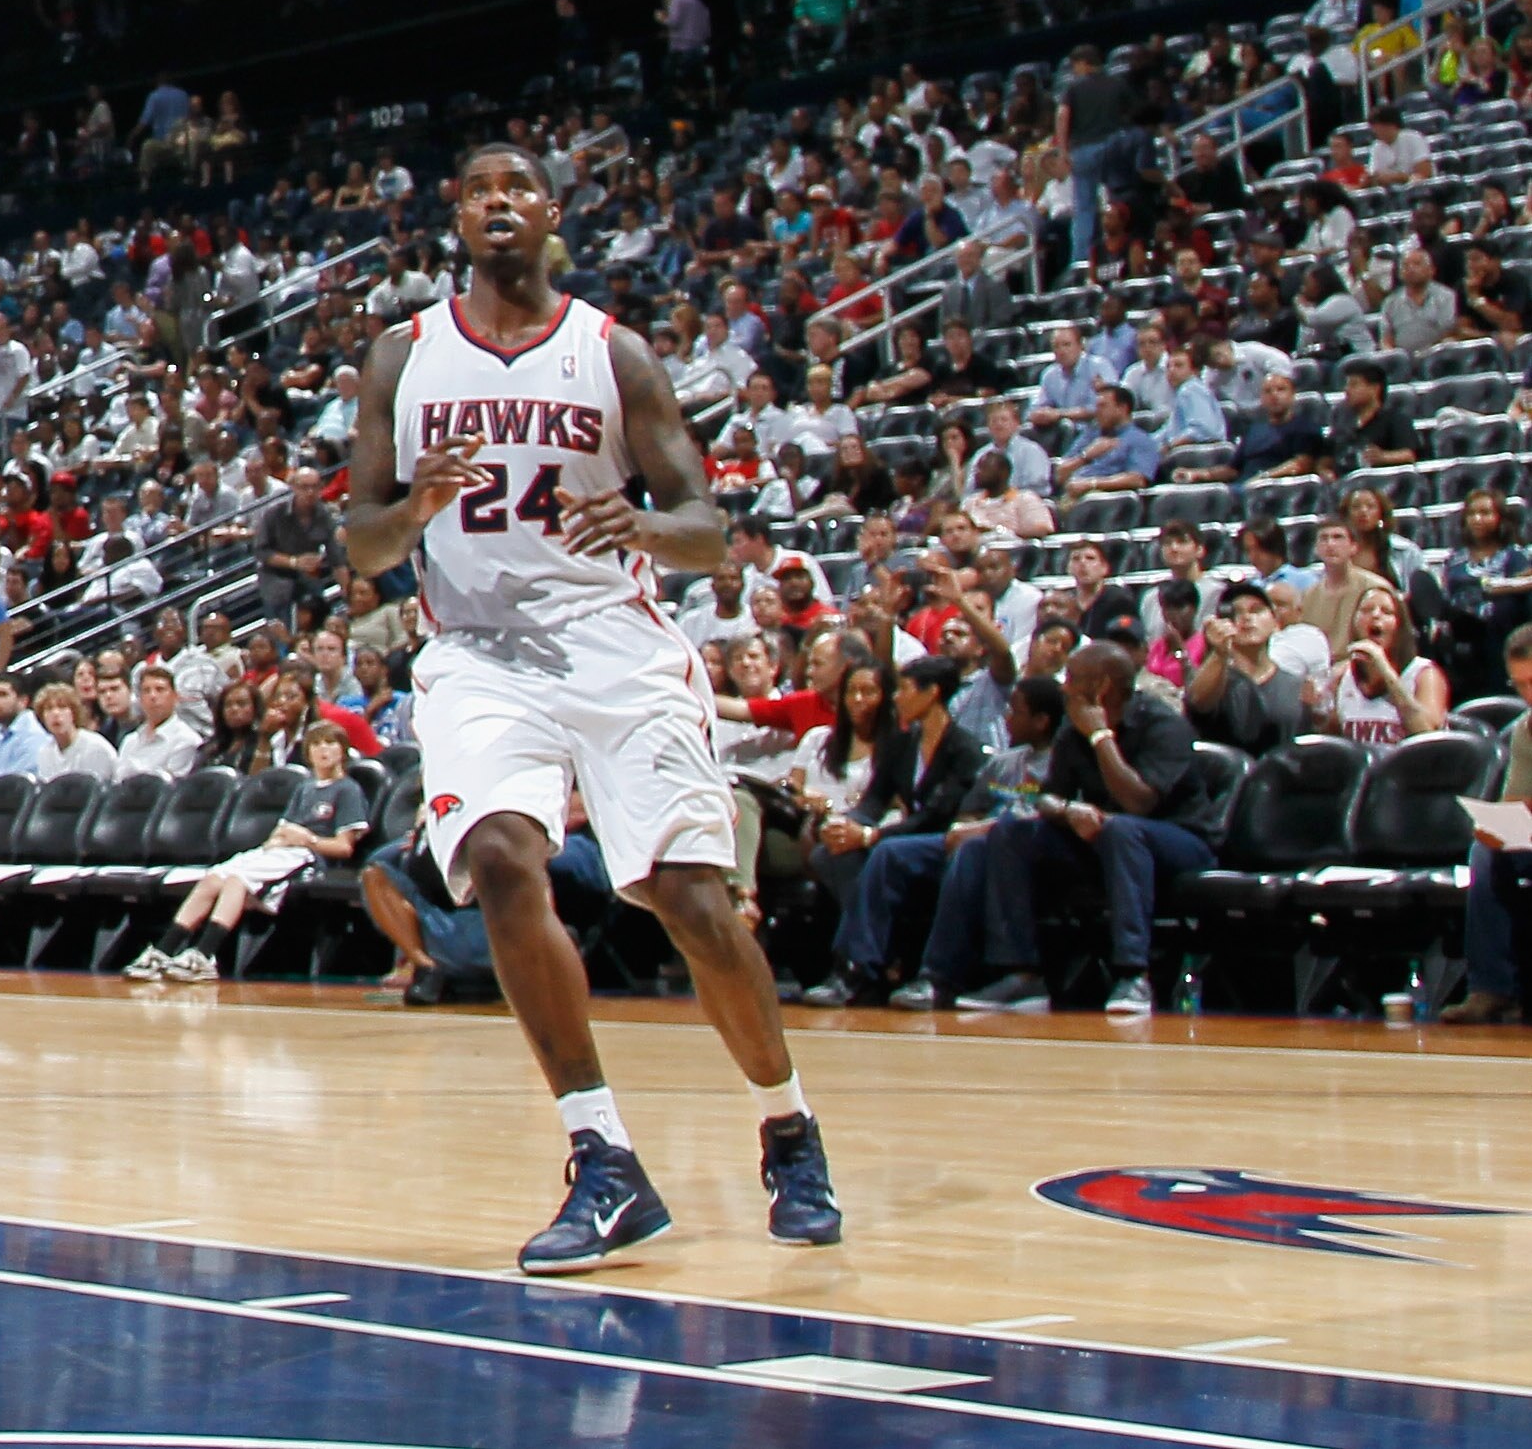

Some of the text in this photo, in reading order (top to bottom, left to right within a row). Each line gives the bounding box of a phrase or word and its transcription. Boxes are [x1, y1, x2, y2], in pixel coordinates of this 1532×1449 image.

[371, 103, 405, 128] 102
[421, 398, 604, 456] HAWKS
[459, 462, 565, 537] 24
